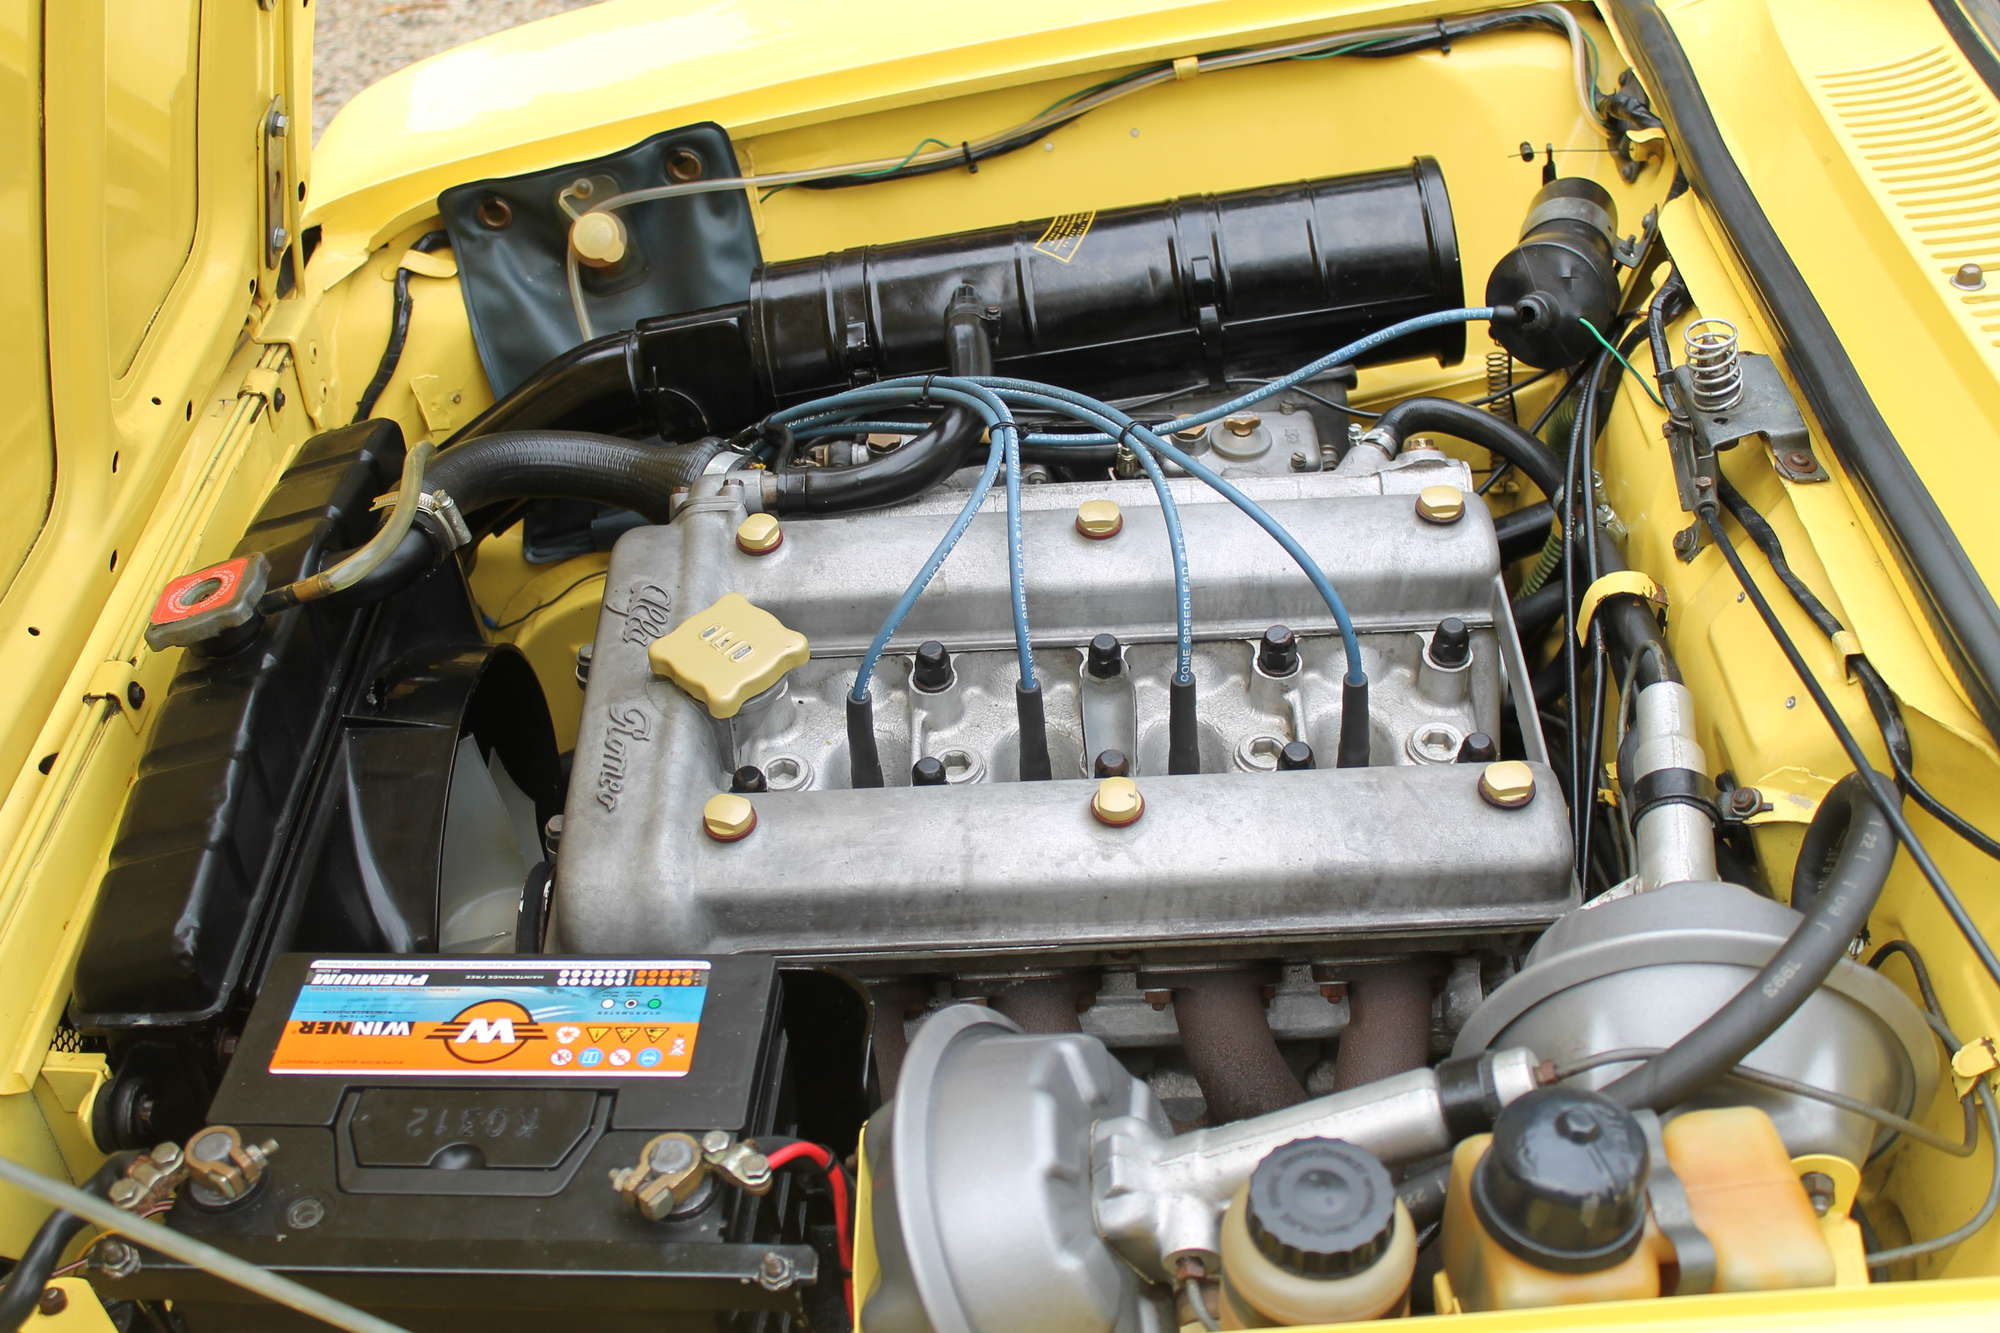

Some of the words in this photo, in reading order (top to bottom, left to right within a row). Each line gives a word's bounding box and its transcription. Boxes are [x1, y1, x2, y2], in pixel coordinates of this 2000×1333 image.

[1359, 326, 1396, 349] LUCAS
[1307, 344, 1356, 374] SILICONE
[1245, 366, 1307, 403] SPEEDLEAD
[605, 583, 673, 648] Alfa
[1181, 566, 1191, 644] SPEEDLEAD
[596, 705, 652, 813] Romeo
[311, 973, 430, 986] PREMIUM
[464, 973, 487, 981] FREE
[489, 973, 545, 981] MAINTENANCE
[297, 1021, 414, 1036] WINNER
[454, 1017, 518, 1044] W
